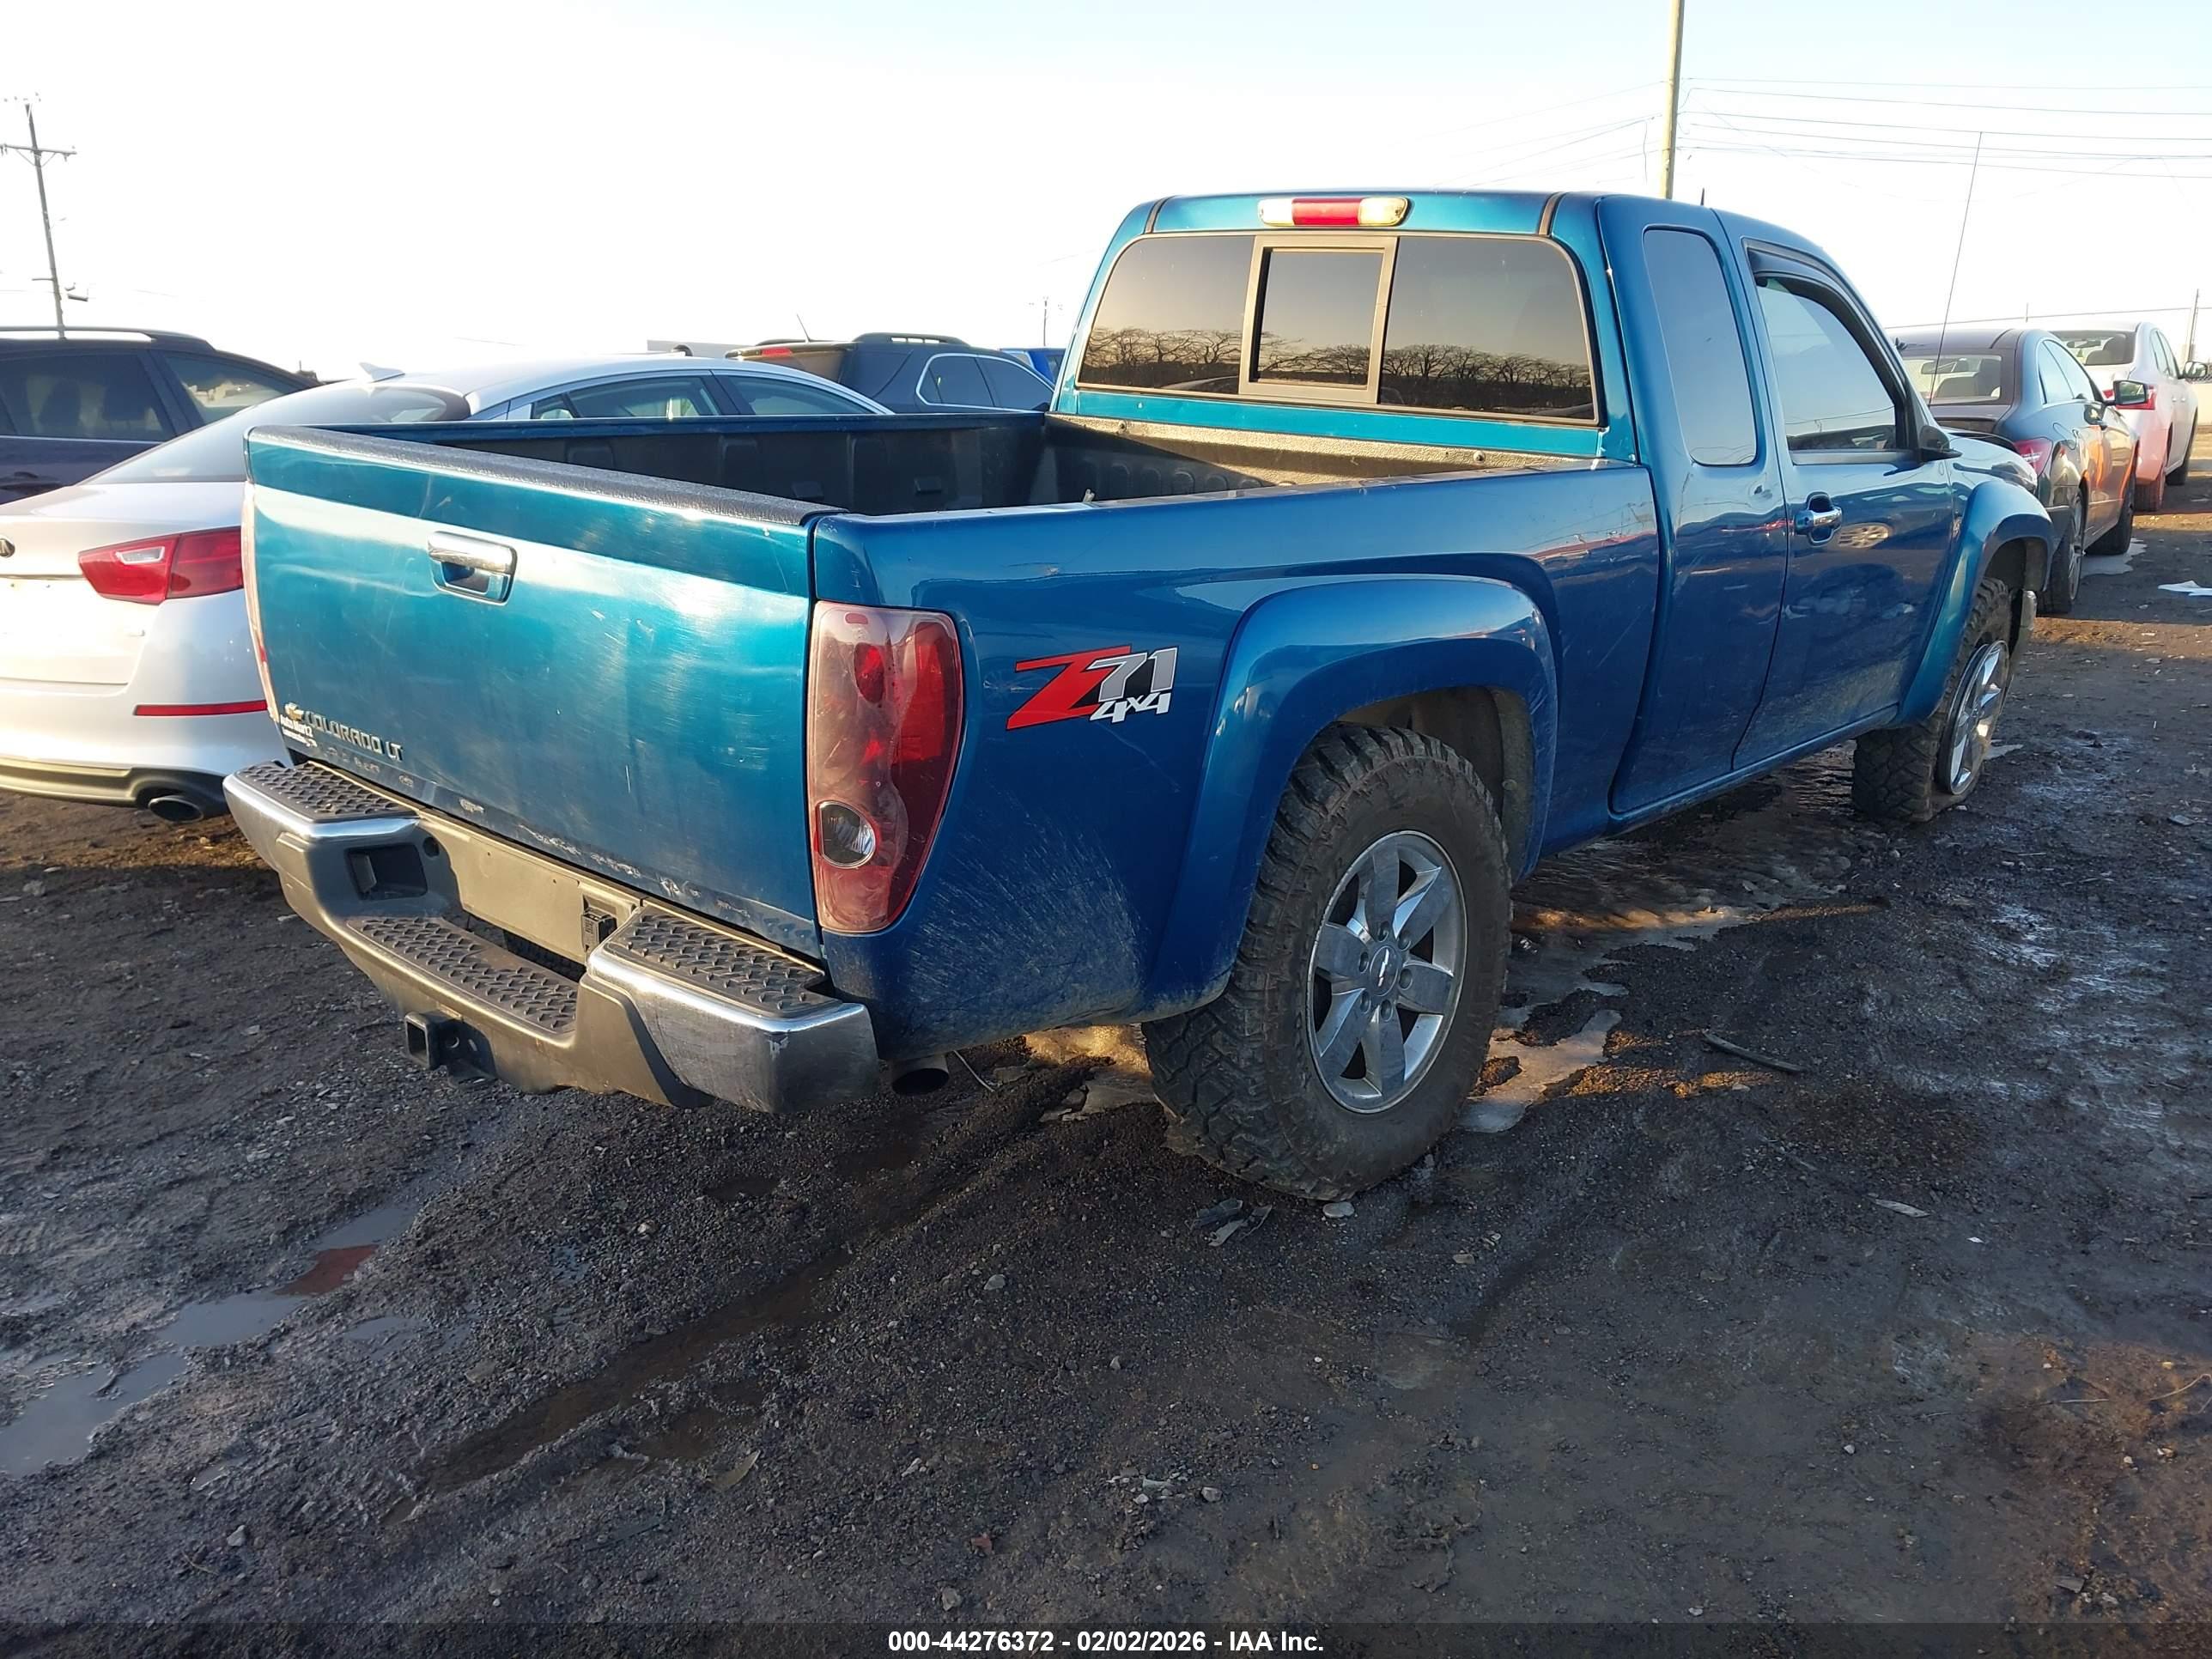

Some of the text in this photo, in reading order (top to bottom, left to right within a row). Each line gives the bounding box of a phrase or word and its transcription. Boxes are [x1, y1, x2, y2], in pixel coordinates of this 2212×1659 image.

[1006, 643, 1179, 731] Z71
[302, 710, 384, 755] COLORADO
[386, 741, 404, 761] LT
